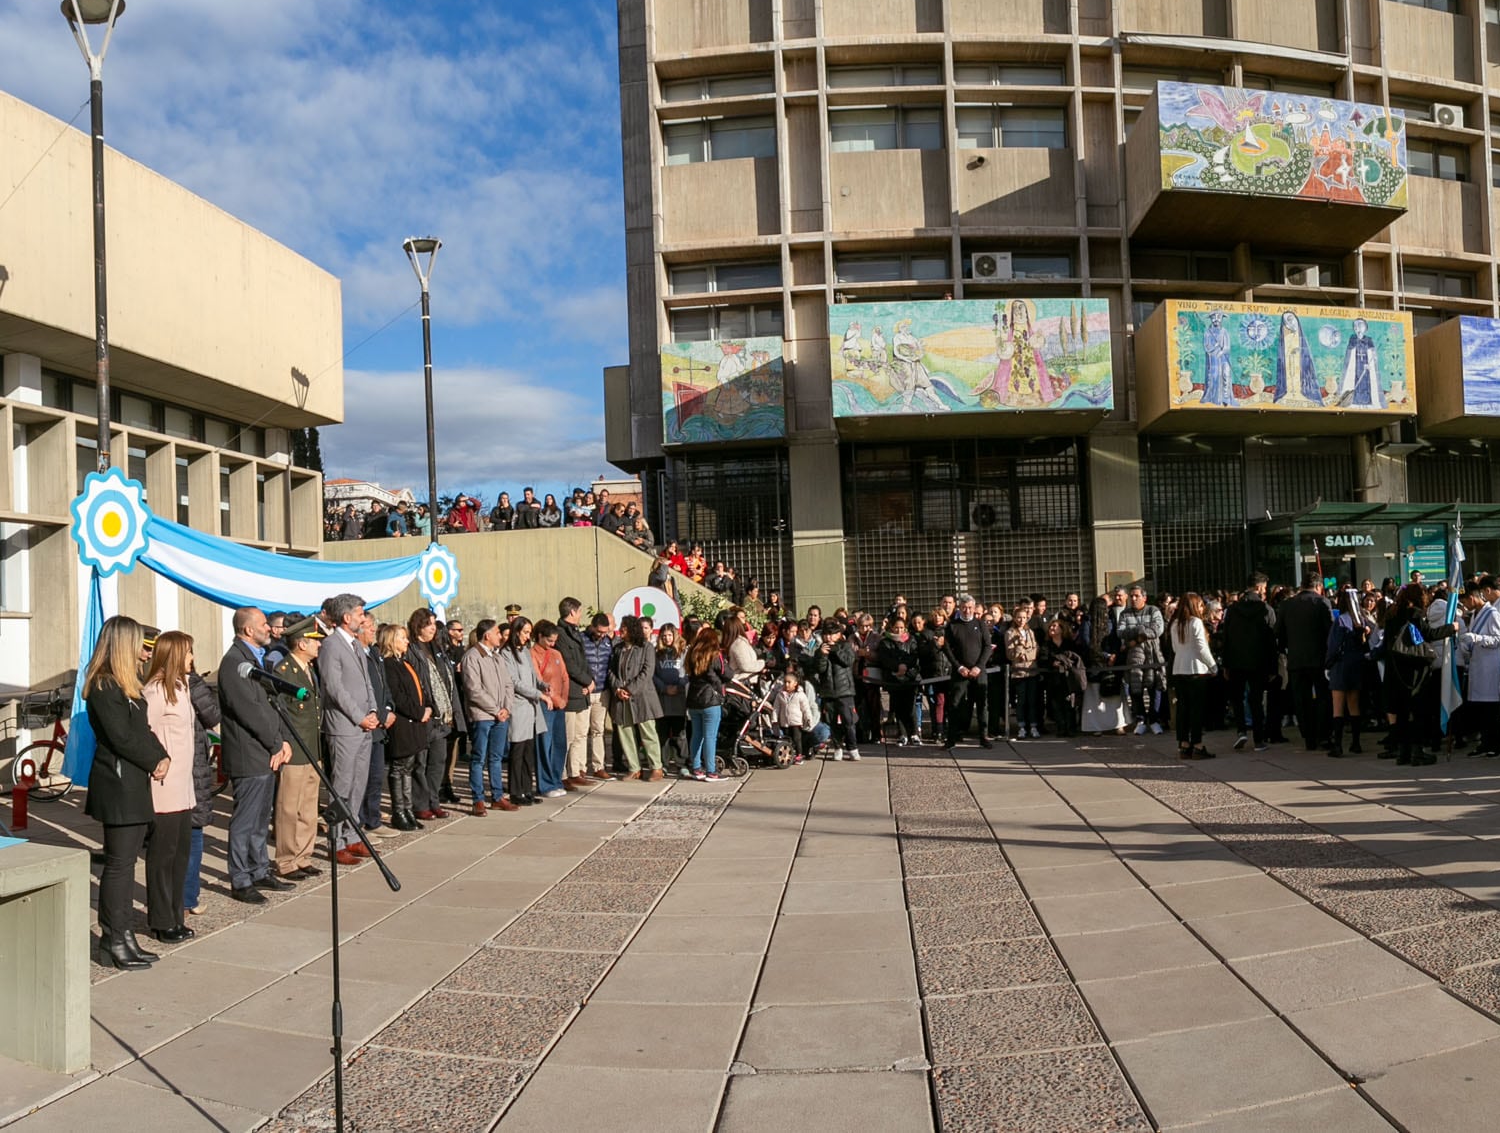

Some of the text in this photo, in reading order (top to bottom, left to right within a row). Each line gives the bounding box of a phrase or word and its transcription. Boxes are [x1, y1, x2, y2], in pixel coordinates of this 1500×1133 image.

[1178, 301, 1198, 310] VINO
[1242, 304, 1269, 313] FRUTO
[1325, 535, 1374, 547] SALIDA
